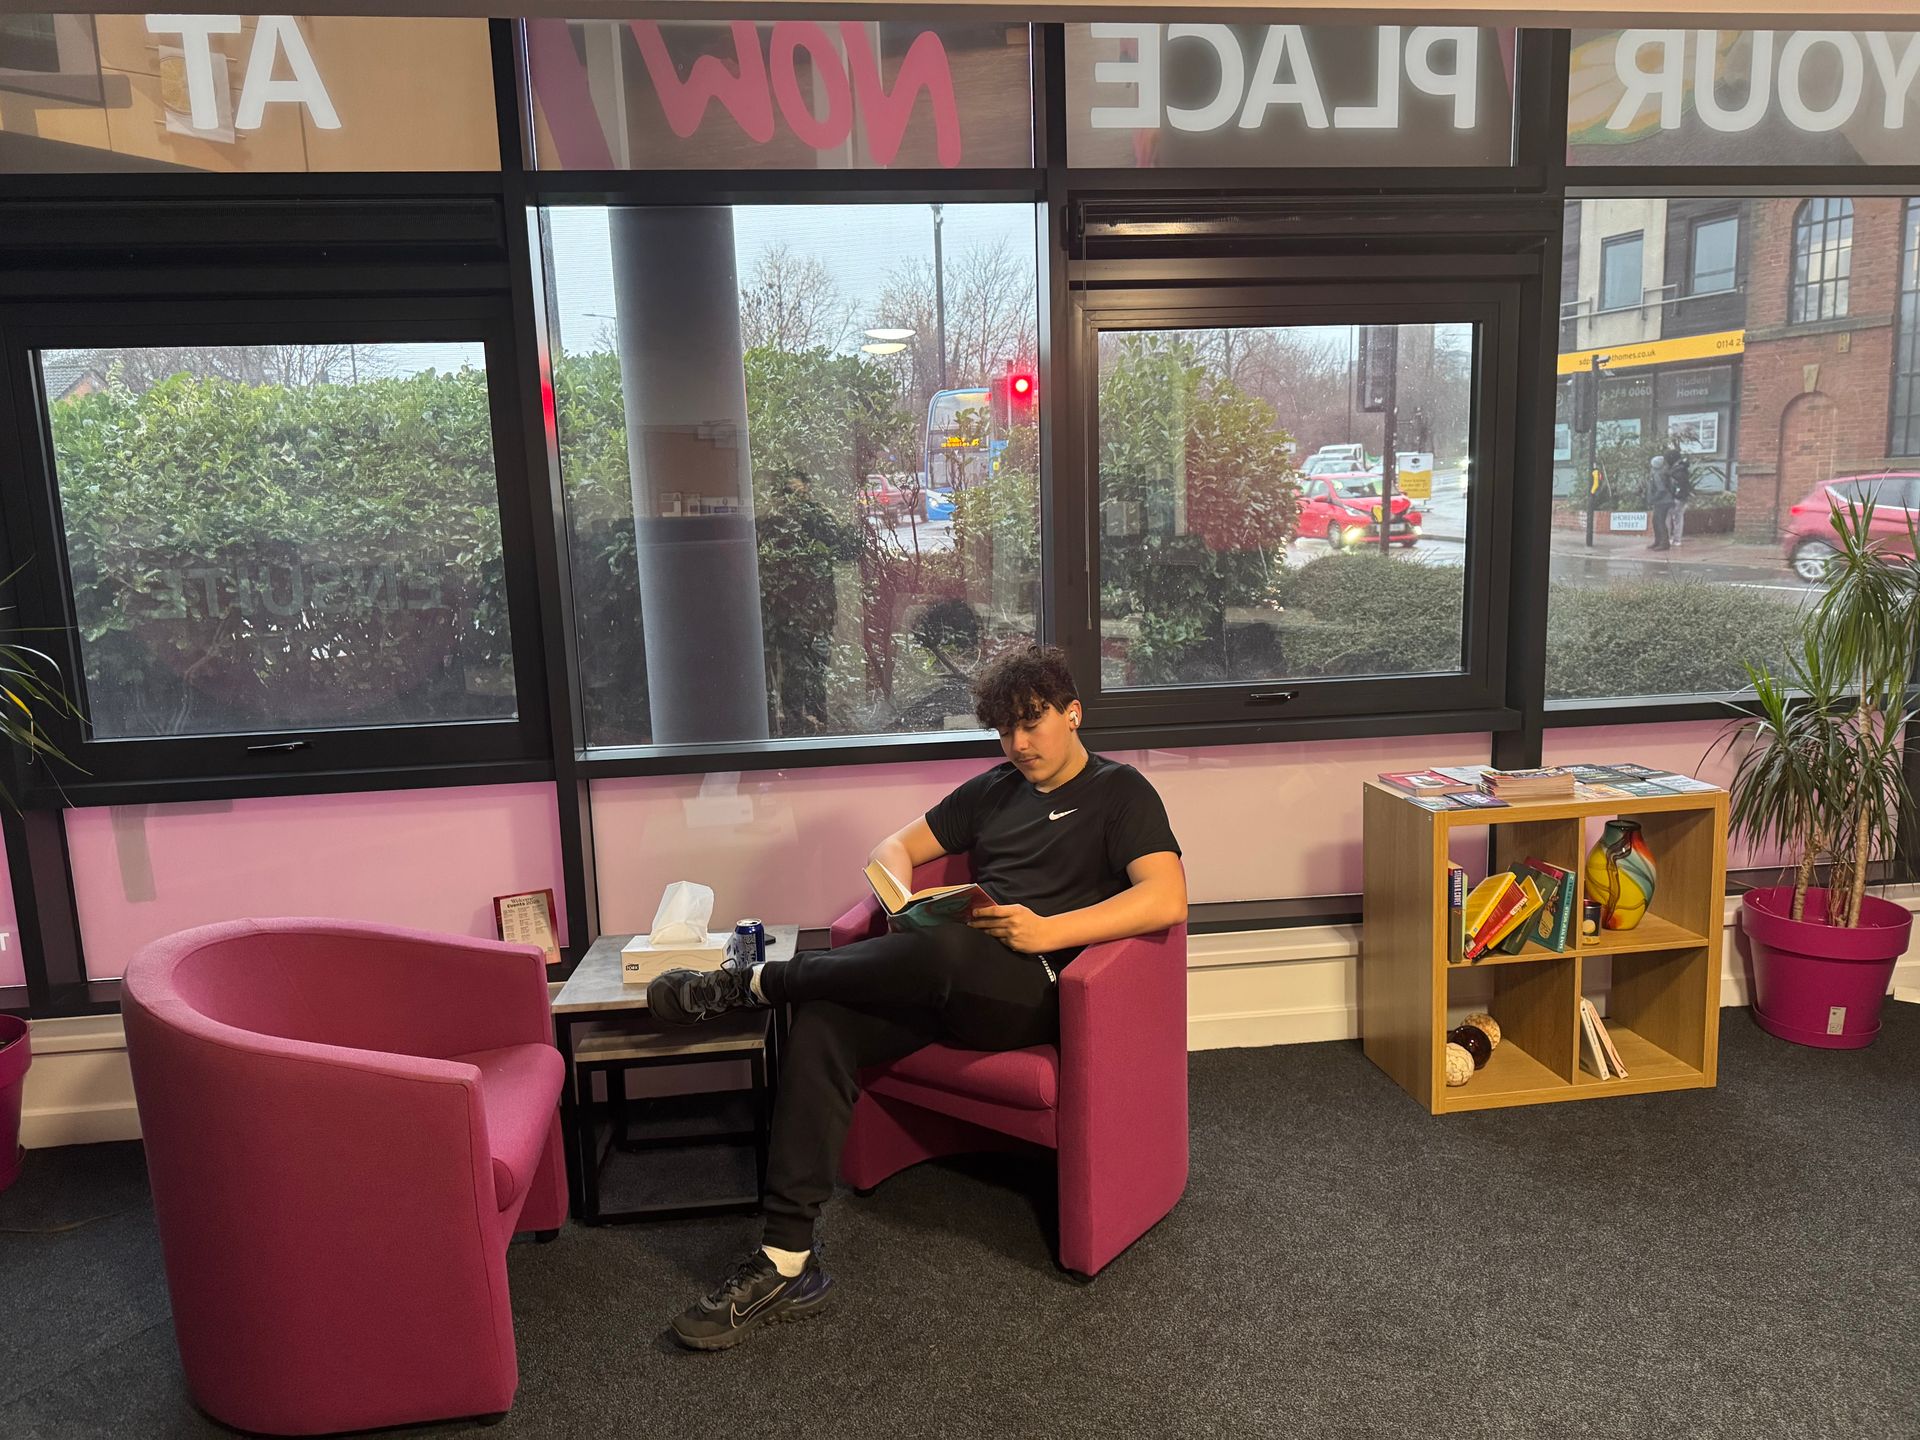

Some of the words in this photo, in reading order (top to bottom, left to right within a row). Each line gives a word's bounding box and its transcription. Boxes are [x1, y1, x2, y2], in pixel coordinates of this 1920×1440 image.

[1716, 338, 1734, 349] 0114
[1676, 374, 1711, 386] Student
[1677, 387, 1709, 398] Homes
